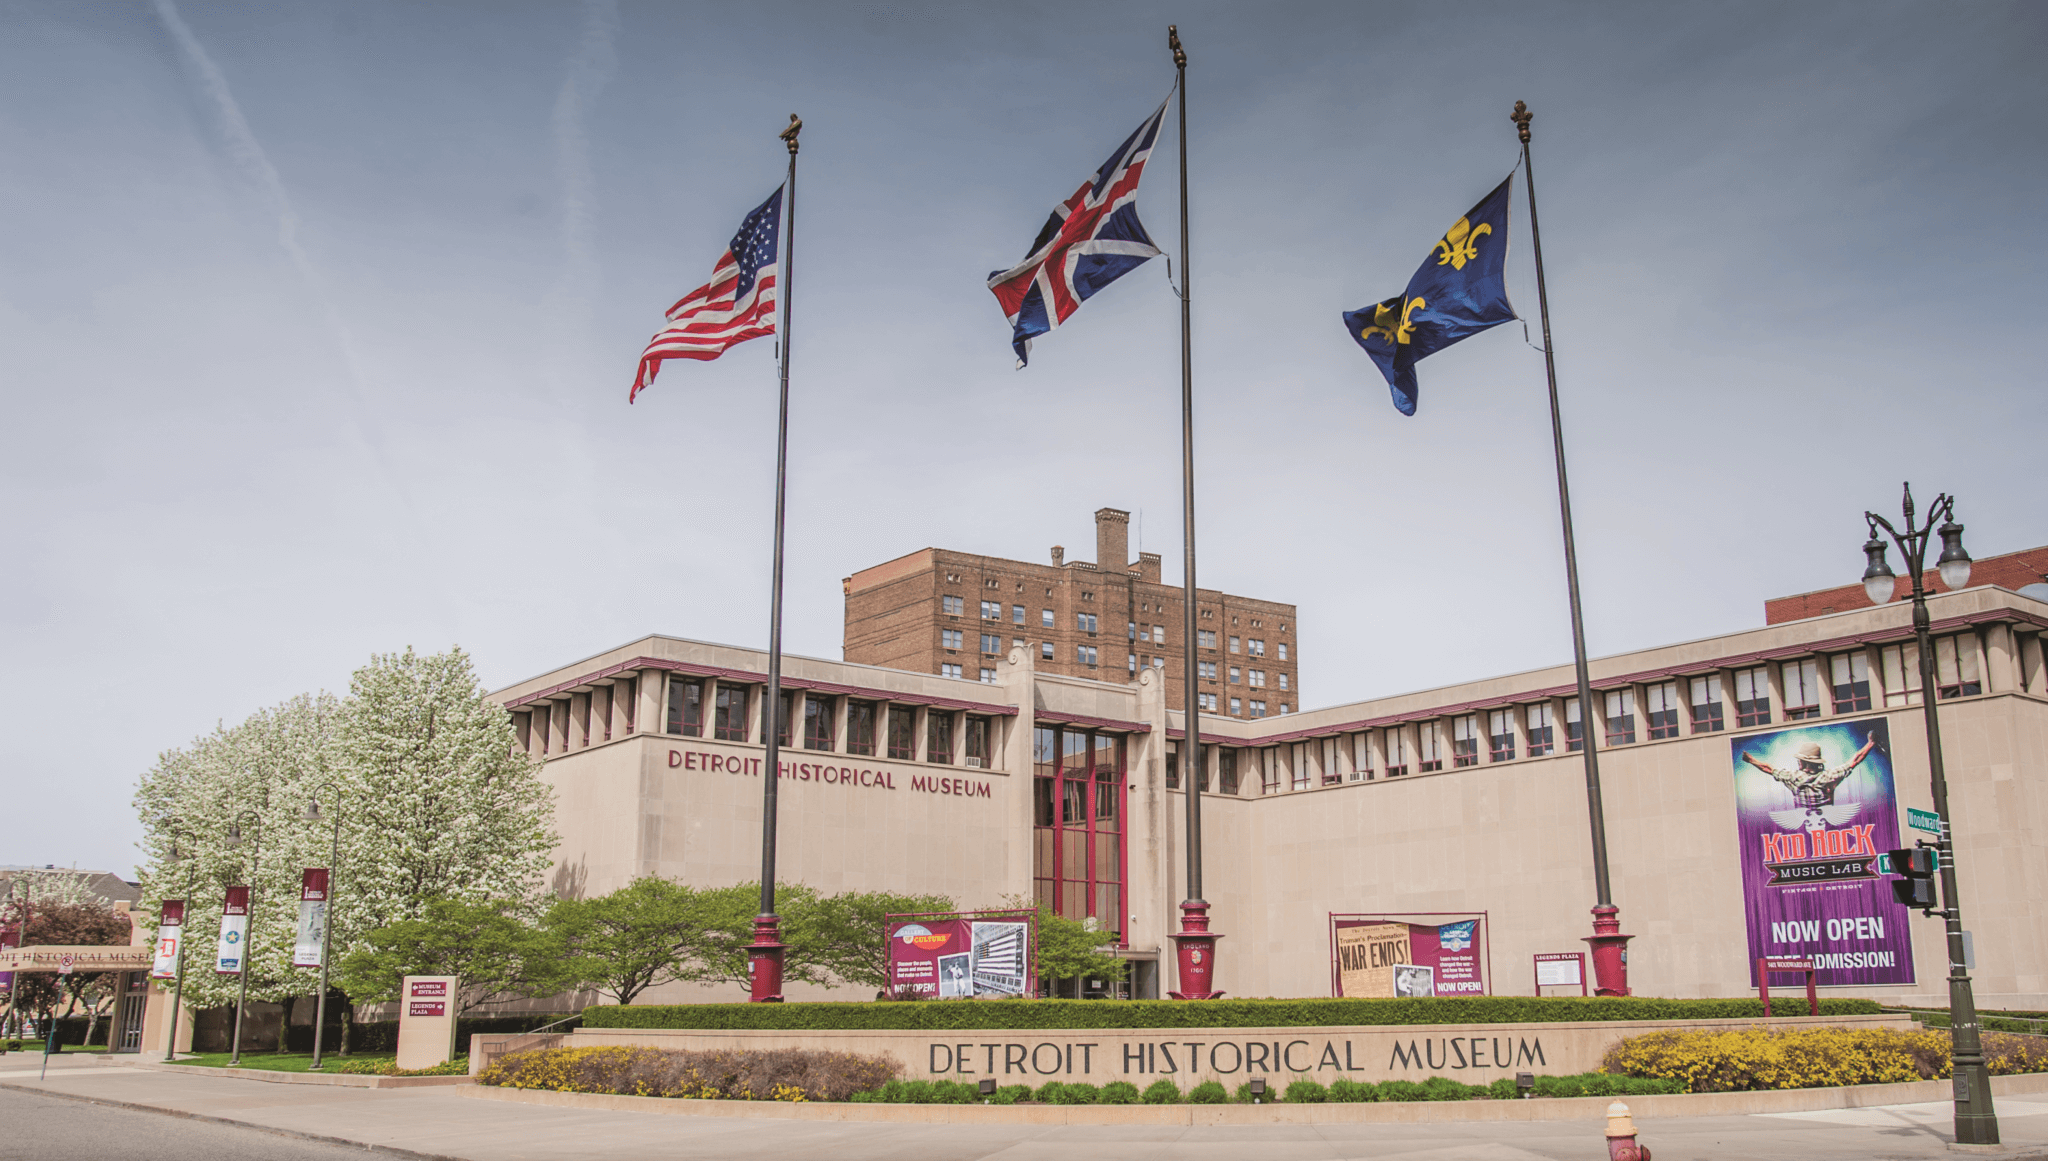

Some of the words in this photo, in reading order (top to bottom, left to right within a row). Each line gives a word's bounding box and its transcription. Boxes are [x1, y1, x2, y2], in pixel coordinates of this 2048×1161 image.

[668, 749, 762, 777] DETROIT
[777, 760, 896, 790] HISTORICAL
[911, 774, 991, 799] MUSEUM
[1907, 811, 1941, 831] Woodward
[1761, 832, 1807, 864] KID
[1810, 823, 1877, 858] ROCK
[1780, 865, 1826, 878] MUSIC
[1831, 863, 1862, 874] LAB
[1781, 886, 1817, 894] VINTAGE
[1825, 883, 1863, 891] DETROIT
[1339, 935, 1366, 944] Truman's
[1771, 919, 1820, 944] NOW
[1826, 916, 1885, 942] OPEN
[1340, 944, 1368, 972] WAR
[1370, 939, 1410, 969] ENDS!
[1436, 982, 1457, 993] NOW
[1457, 981, 1482, 992] OPEN!
[929, 1042, 1099, 1075] DETROIT
[1123, 1040, 1365, 1075] HISTORICAL
[1389, 1036, 1547, 1071] MUSEUM
